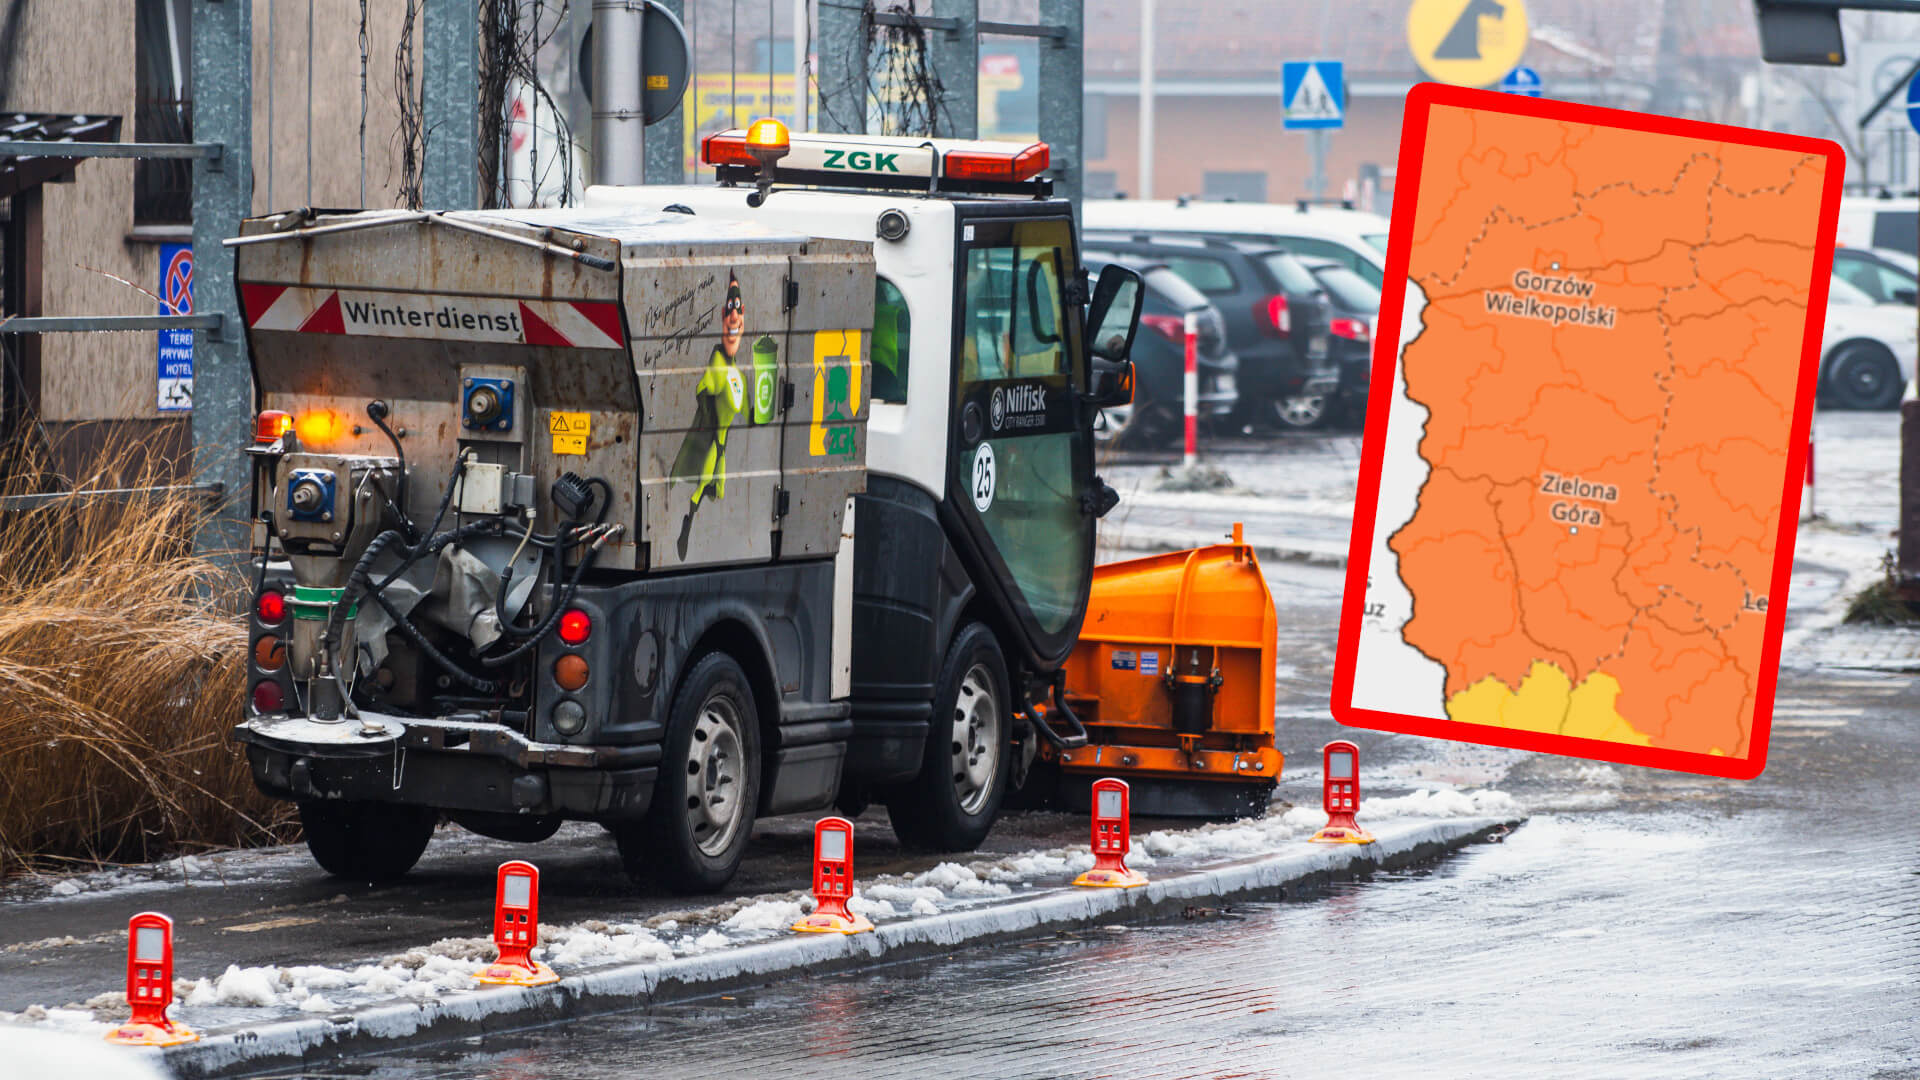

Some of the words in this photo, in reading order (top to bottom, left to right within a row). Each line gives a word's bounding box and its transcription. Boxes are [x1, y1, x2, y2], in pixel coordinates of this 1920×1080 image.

[823, 149, 900, 173] ZGK
[344, 300, 520, 333] Winterdienst
[1006, 384, 1047, 414] Nilfisk
[828, 426, 857, 456] ZGK
[976, 456, 992, 498] 25
